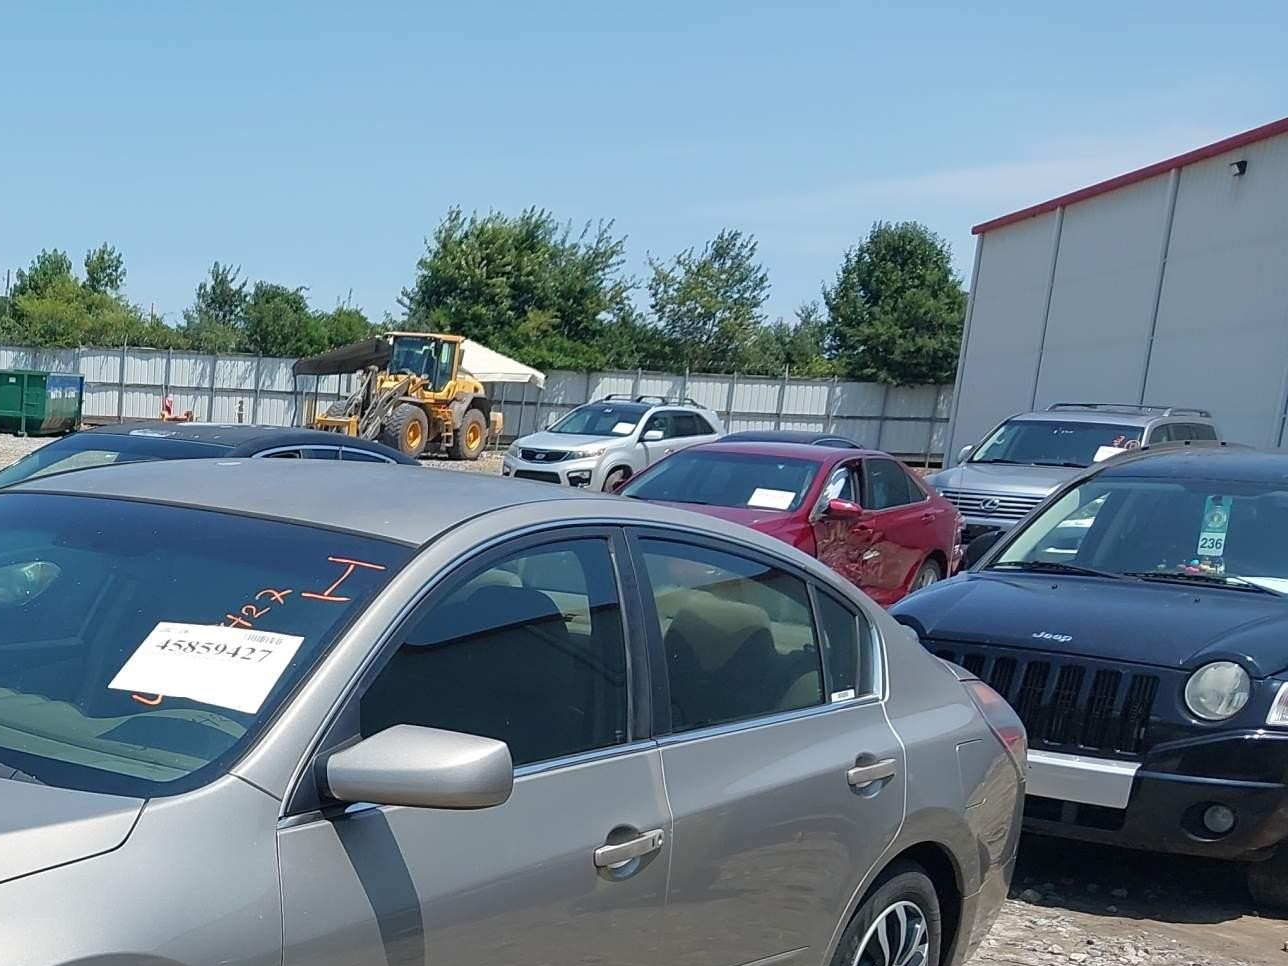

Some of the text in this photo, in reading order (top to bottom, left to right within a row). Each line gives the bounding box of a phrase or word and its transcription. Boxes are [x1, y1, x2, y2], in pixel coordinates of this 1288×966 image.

[1199, 537, 1223, 549] 236
[1032, 631, 1073, 642] Jeep
[155, 638, 273, 663] 45859427
